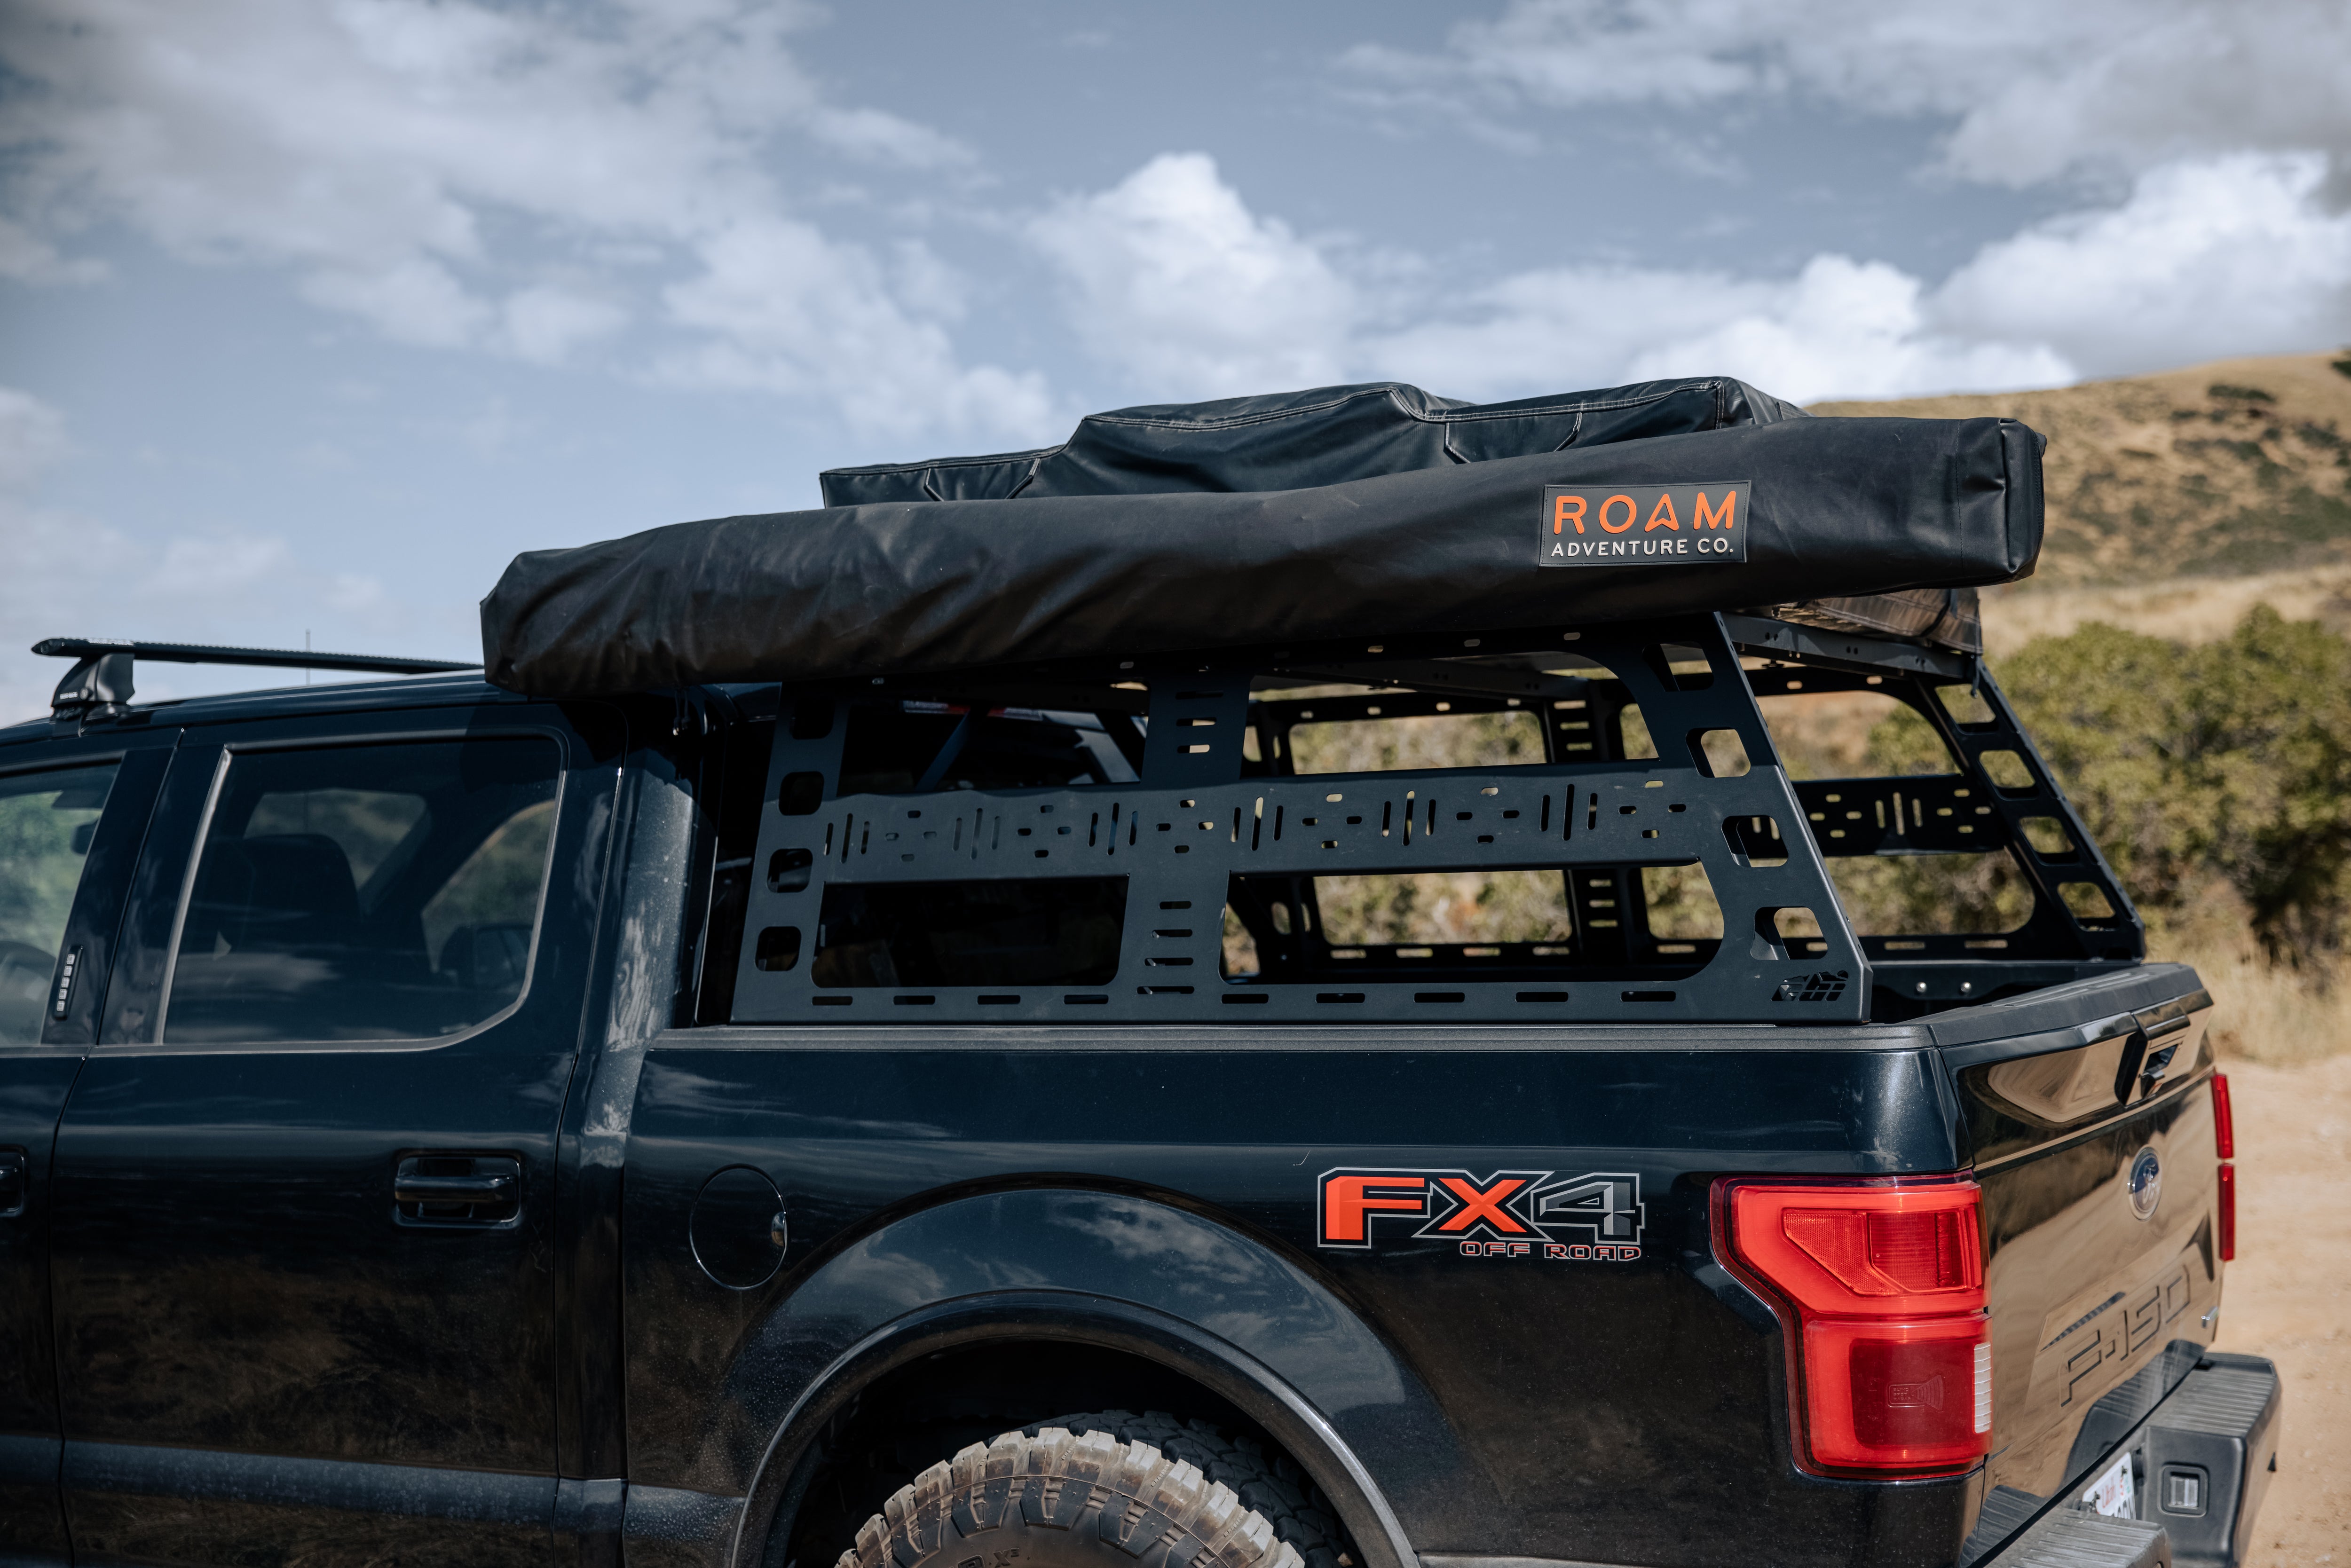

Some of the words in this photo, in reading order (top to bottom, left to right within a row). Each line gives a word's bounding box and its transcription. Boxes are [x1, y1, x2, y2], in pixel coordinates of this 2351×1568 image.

[1553, 490, 1736, 535] ROAM
[1551, 539, 1688, 557] ADVENTURE
[1697, 537, 1734, 554] CO.
[1317, 1167, 1645, 1248] FX4
[1459, 1241, 1531, 1257] OFF
[1544, 1243, 1641, 1261] ROAD
